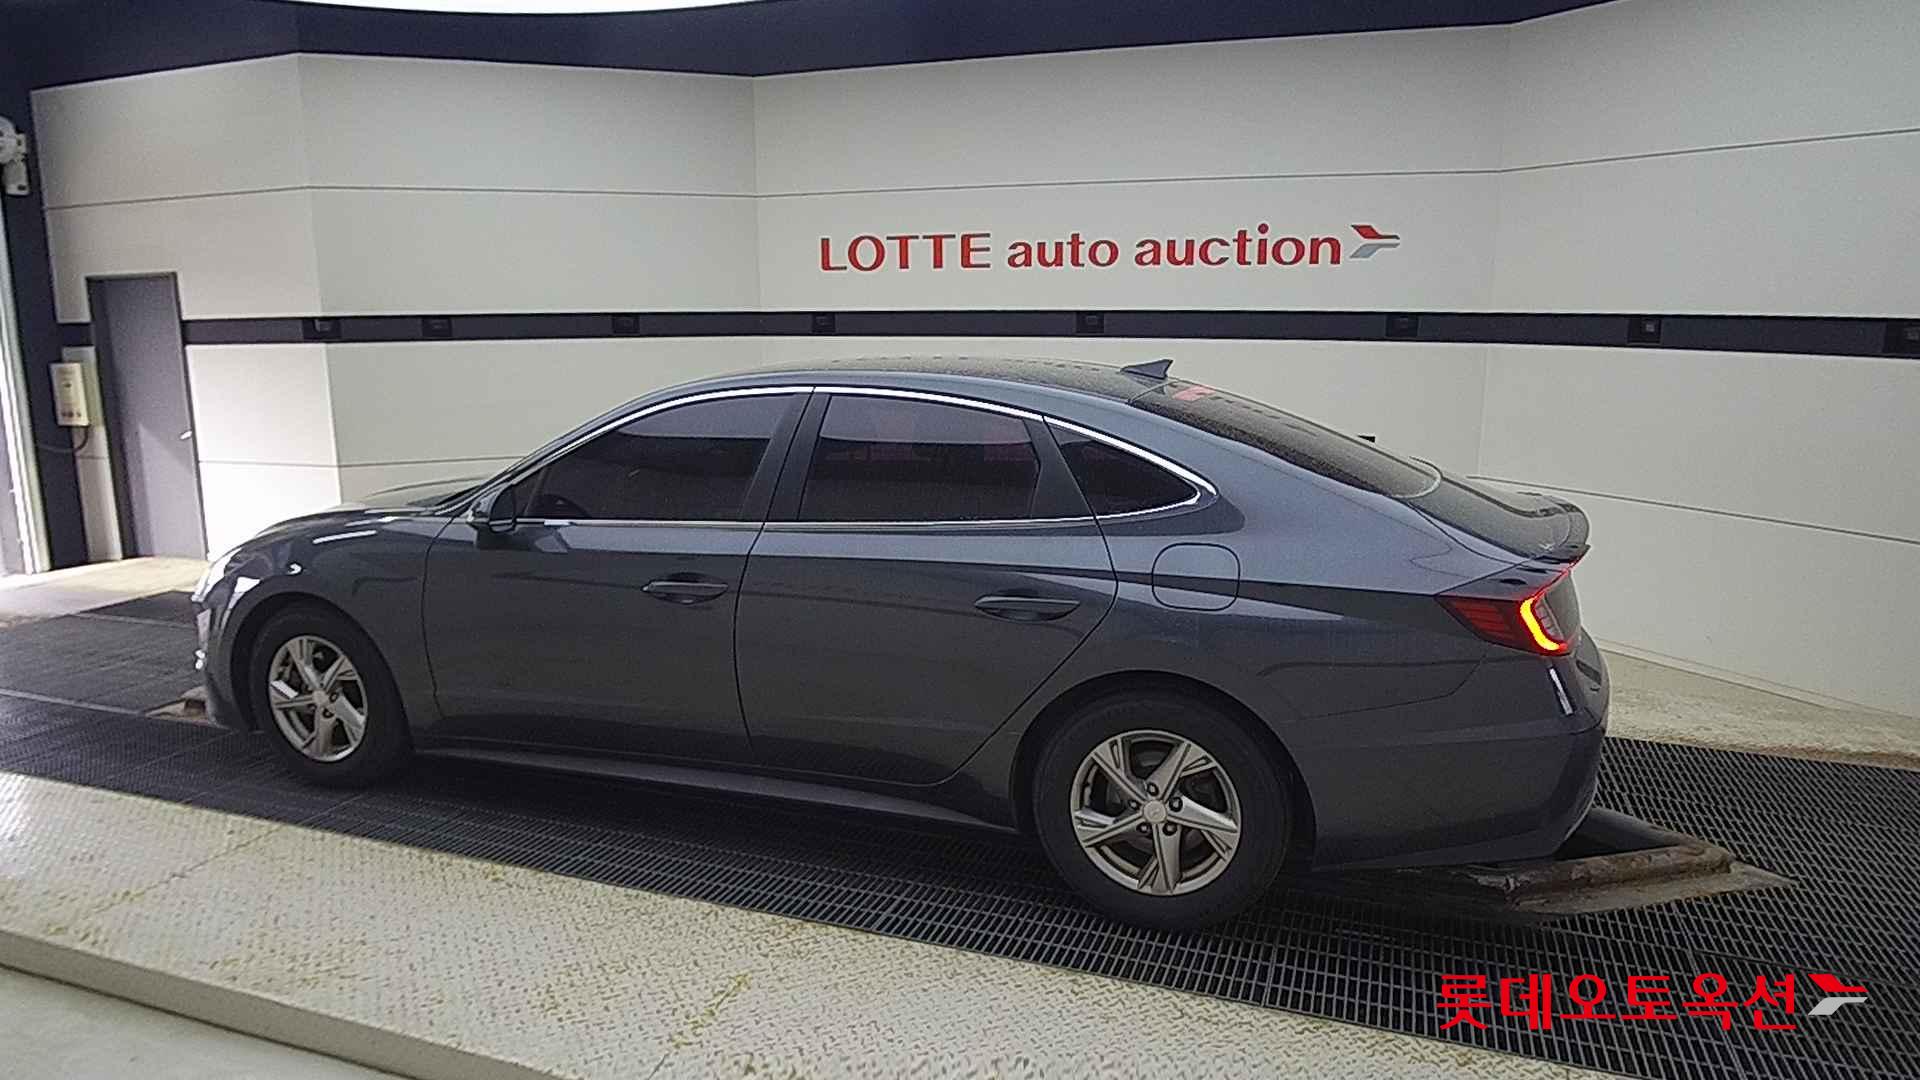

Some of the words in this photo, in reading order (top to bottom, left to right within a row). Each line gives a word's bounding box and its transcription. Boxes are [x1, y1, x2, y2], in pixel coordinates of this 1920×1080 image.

[819, 232, 992, 273] LOTTE
[1006, 233, 1121, 269] auto
[1133, 223, 1342, 268] auction
